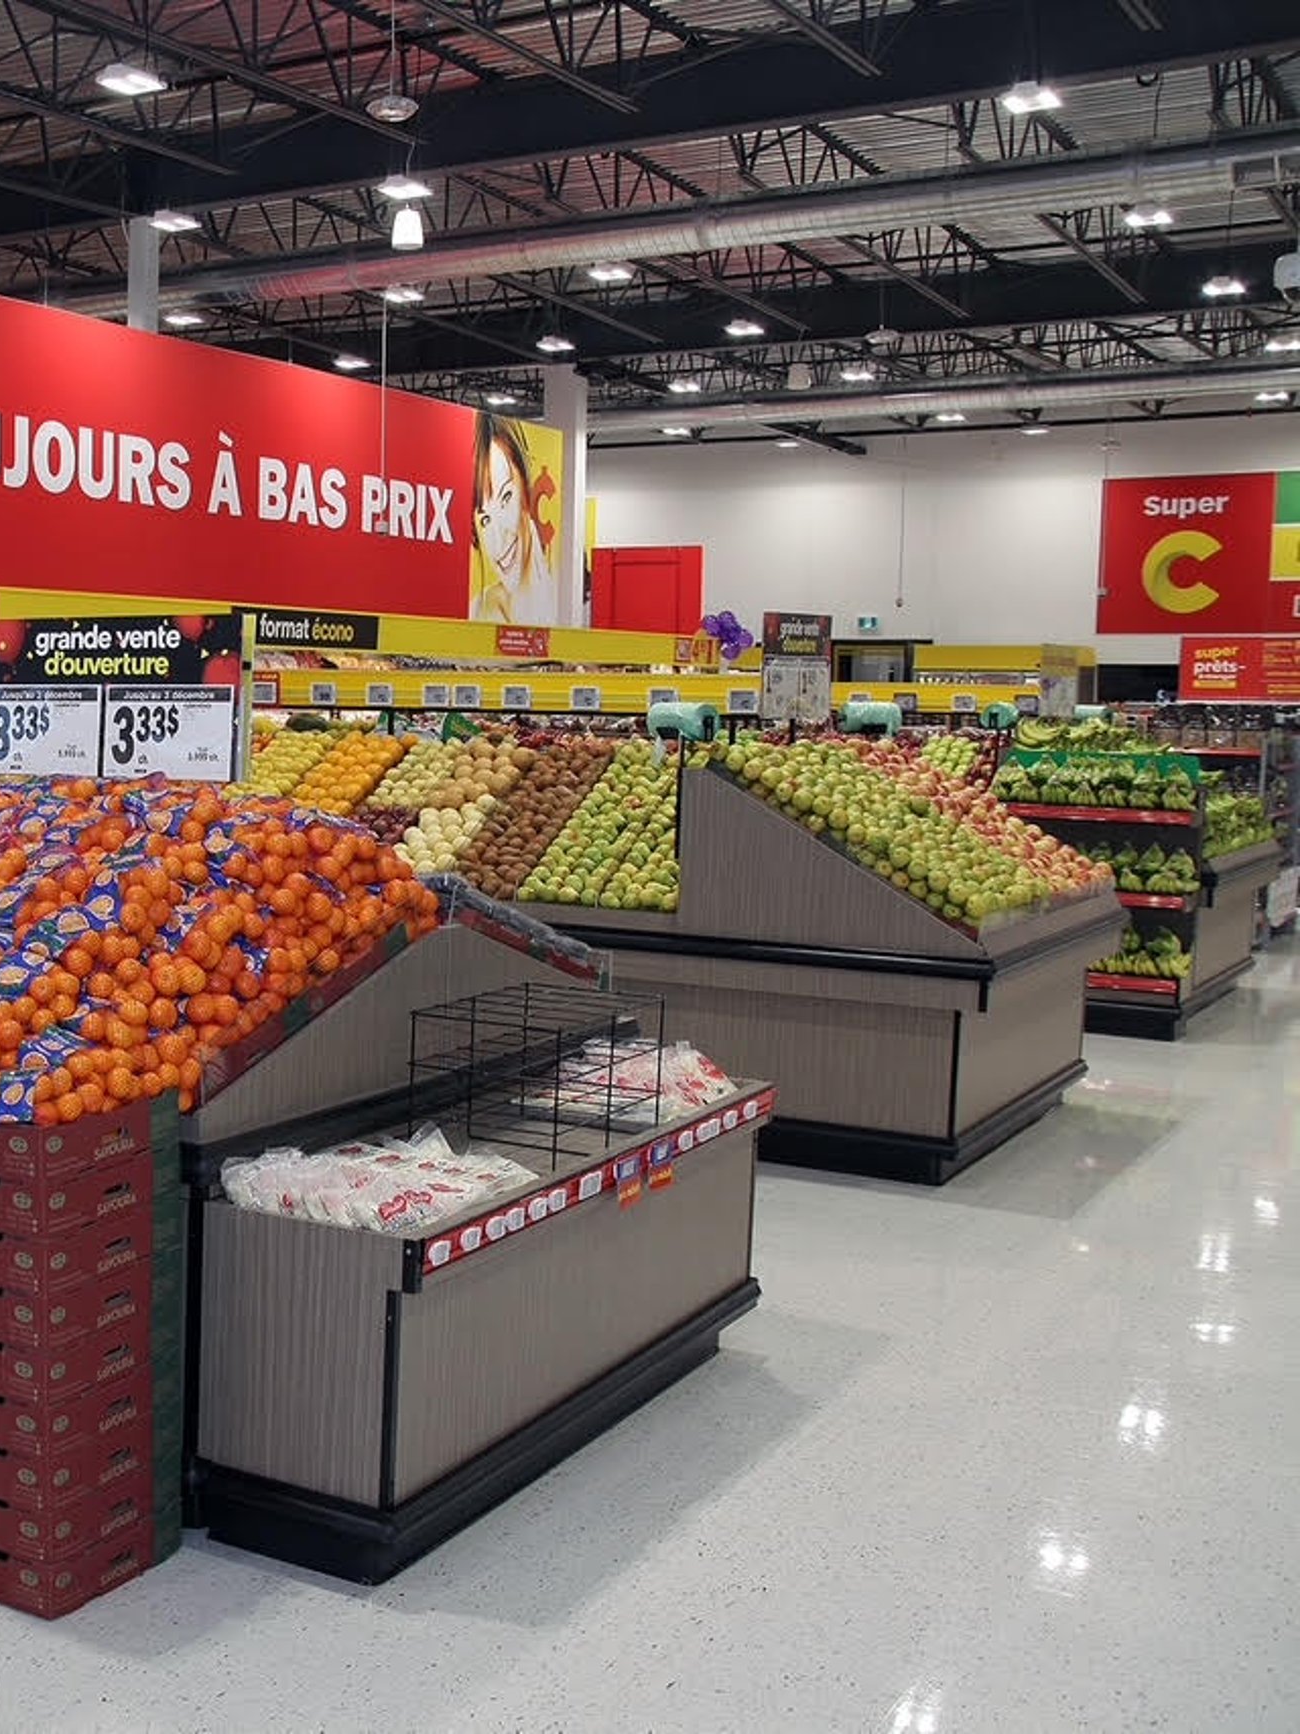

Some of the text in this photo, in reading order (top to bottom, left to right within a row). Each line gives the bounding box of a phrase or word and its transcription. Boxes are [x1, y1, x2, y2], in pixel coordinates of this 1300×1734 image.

[208, 431, 242, 515] À
[258, 456, 346, 529] BAS
[361, 479, 454, 544] PRIX
[1143, 495, 1230, 519] Super
[1141, 529, 1224, 614] C
[35, 624, 181, 655] grande vente
[259, 613, 354, 642] format écono
[44, 652, 170, 676] d'ouverture
[1194, 646, 1240, 661] super
[172, 690, 215, 699] décembre
